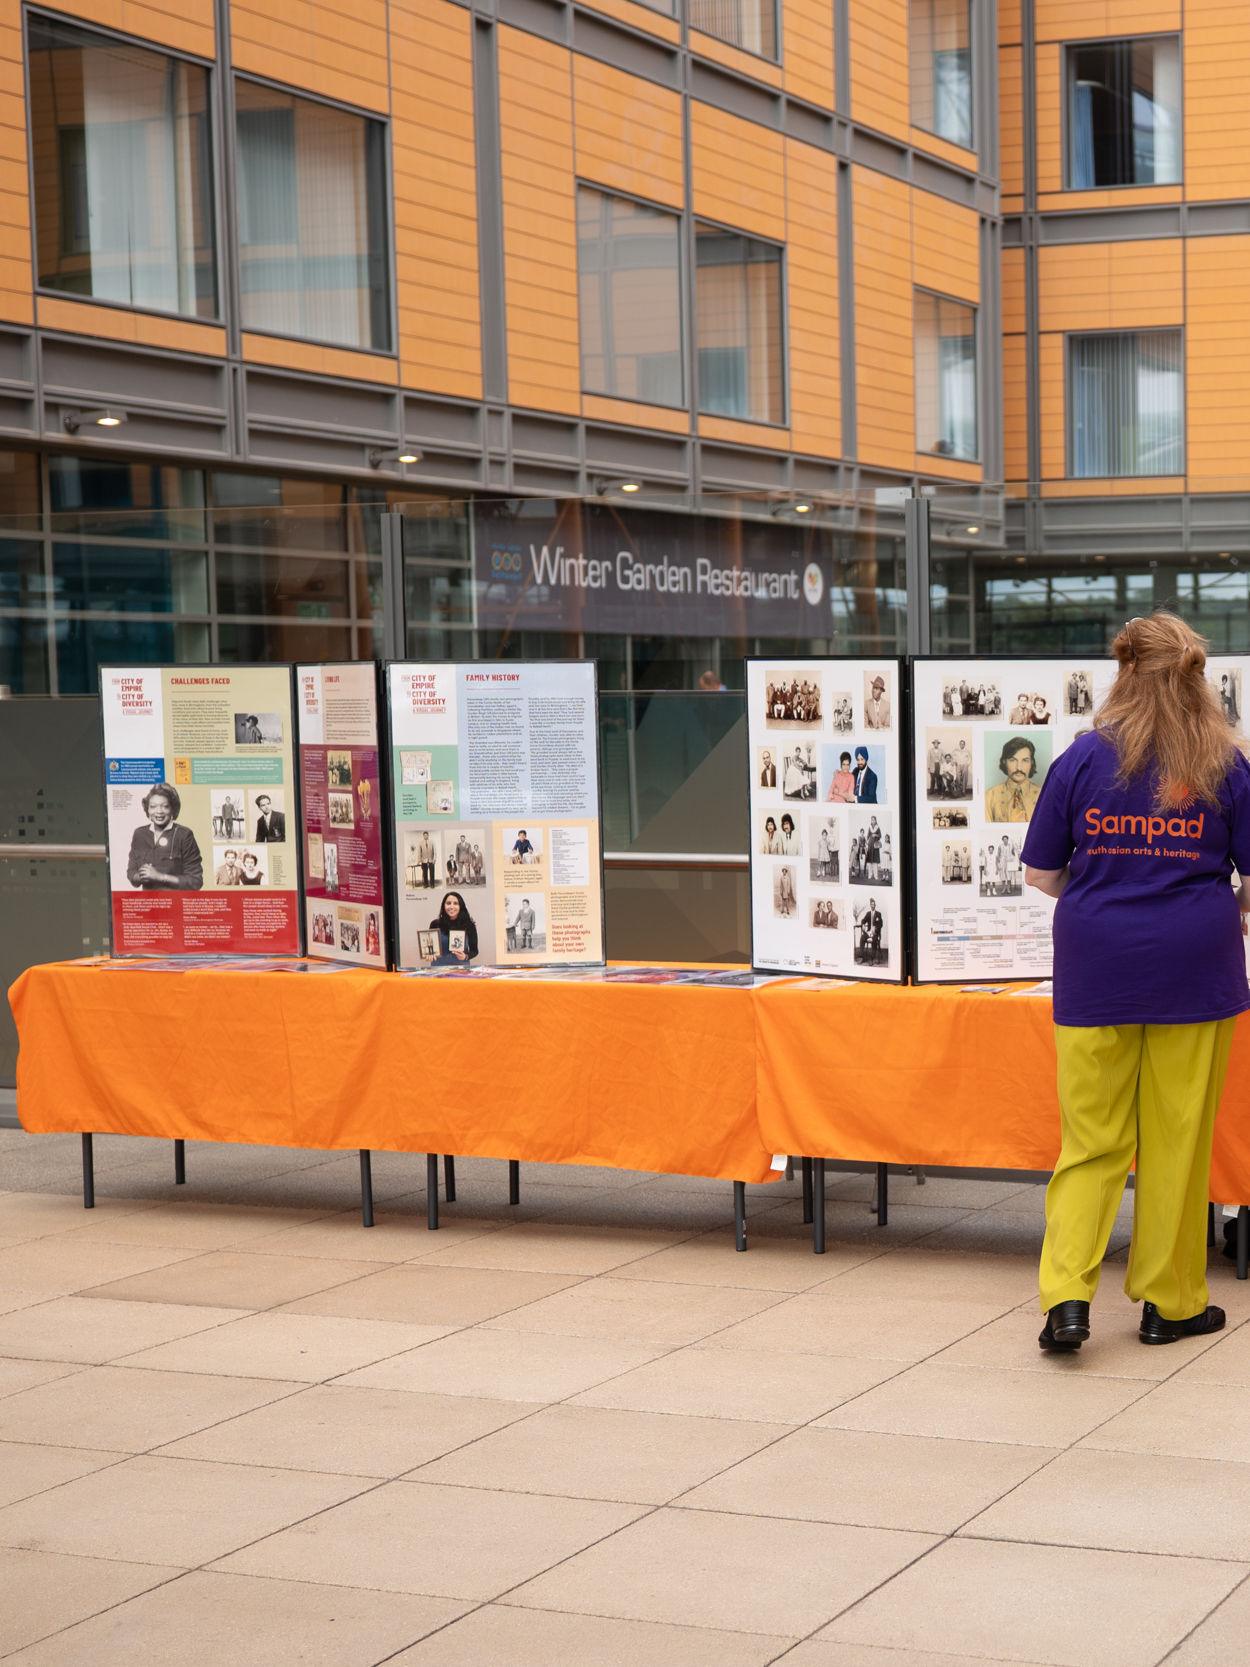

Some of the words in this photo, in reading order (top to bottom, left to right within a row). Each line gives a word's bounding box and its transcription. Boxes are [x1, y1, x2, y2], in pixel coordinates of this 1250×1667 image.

[529, 544, 612, 589] Winter
[616, 551, 692, 593] Garden
[696, 558, 799, 600] Restaurant
[1085, 808, 1204, 844] Sampad
[1133, 847, 1152, 855] arts
[1163, 848, 1200, 860] heritage
